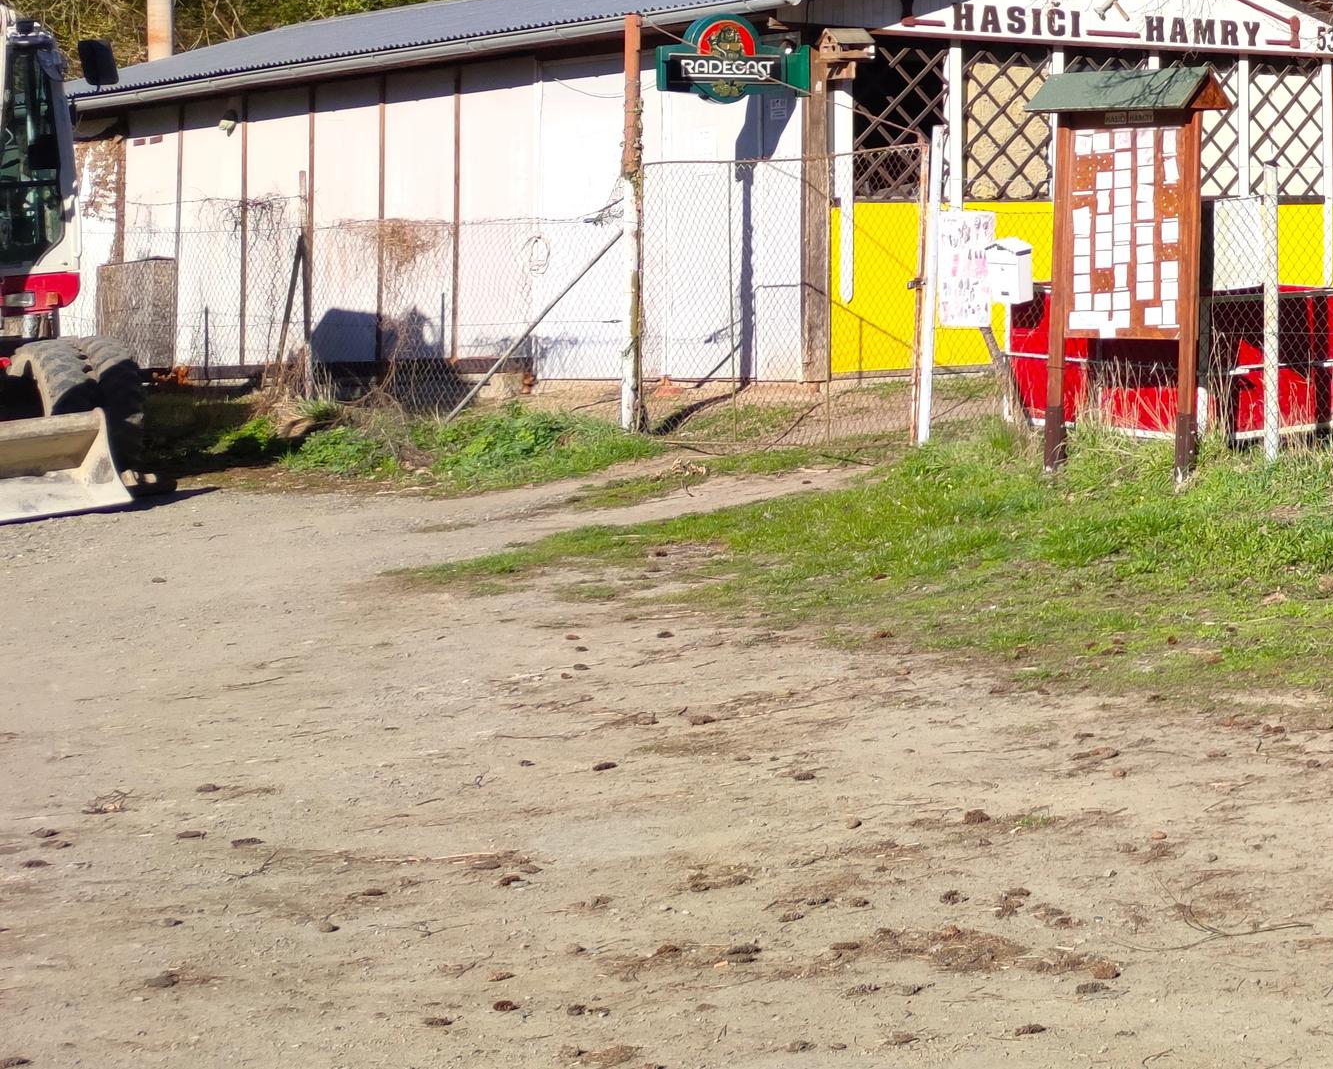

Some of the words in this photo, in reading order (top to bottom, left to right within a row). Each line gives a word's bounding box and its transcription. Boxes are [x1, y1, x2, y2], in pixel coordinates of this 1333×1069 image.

[952, 2, 1081, 37] HASIČI
[1145, 16, 1260, 46] HAMRY
[681, 60, 775, 80] RADEGAST
